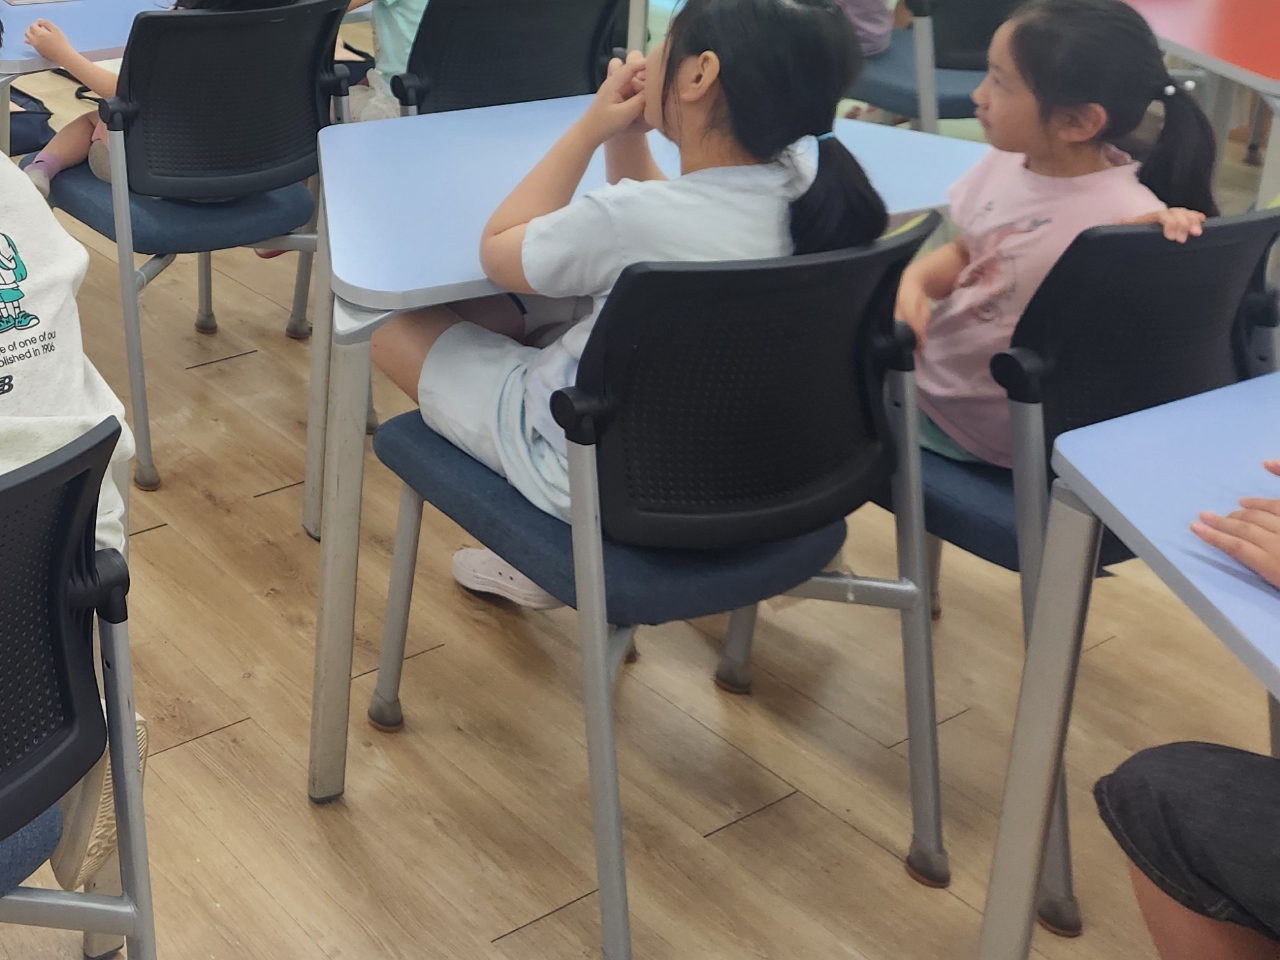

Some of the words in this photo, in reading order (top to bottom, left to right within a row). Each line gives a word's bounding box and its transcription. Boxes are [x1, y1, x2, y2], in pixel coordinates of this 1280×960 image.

[7, 341, 18, 352] of
[18, 336, 38, 349] one
[38, 331, 47, 343] of
[33, 347, 41, 357] in
